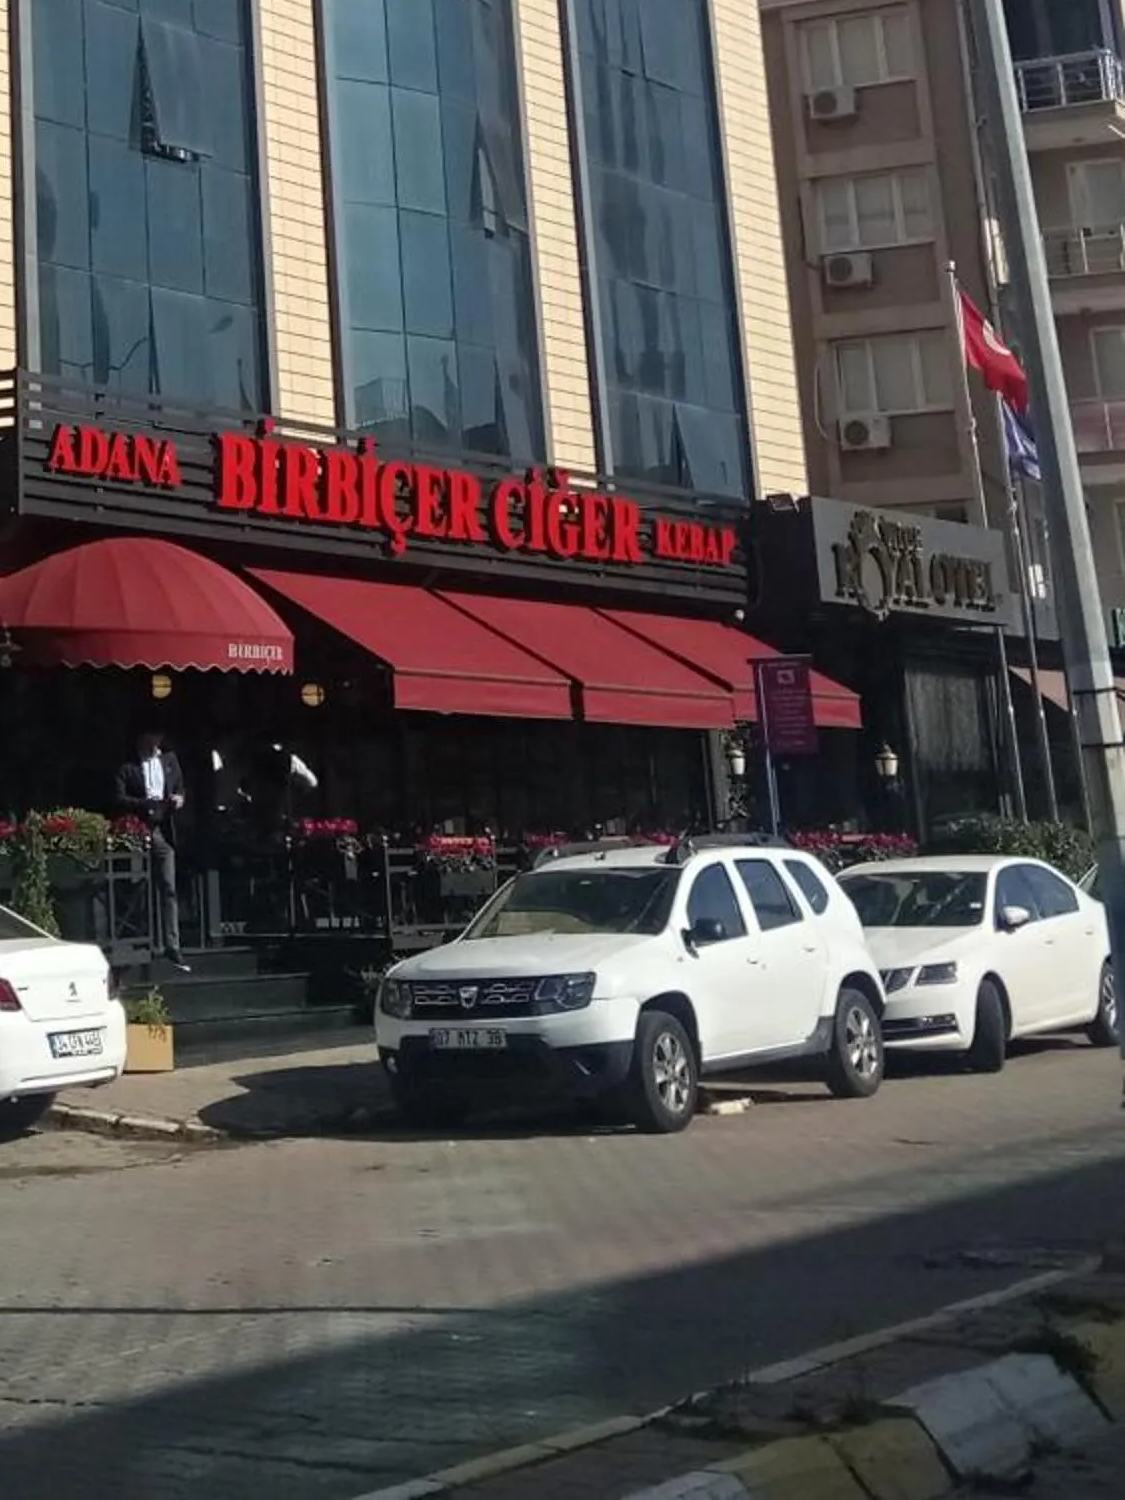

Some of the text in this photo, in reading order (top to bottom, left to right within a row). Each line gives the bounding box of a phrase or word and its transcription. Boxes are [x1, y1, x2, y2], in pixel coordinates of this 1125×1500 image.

[48, 419, 738, 566] ADANA BİRBİÇER CİĞER KEBAP
